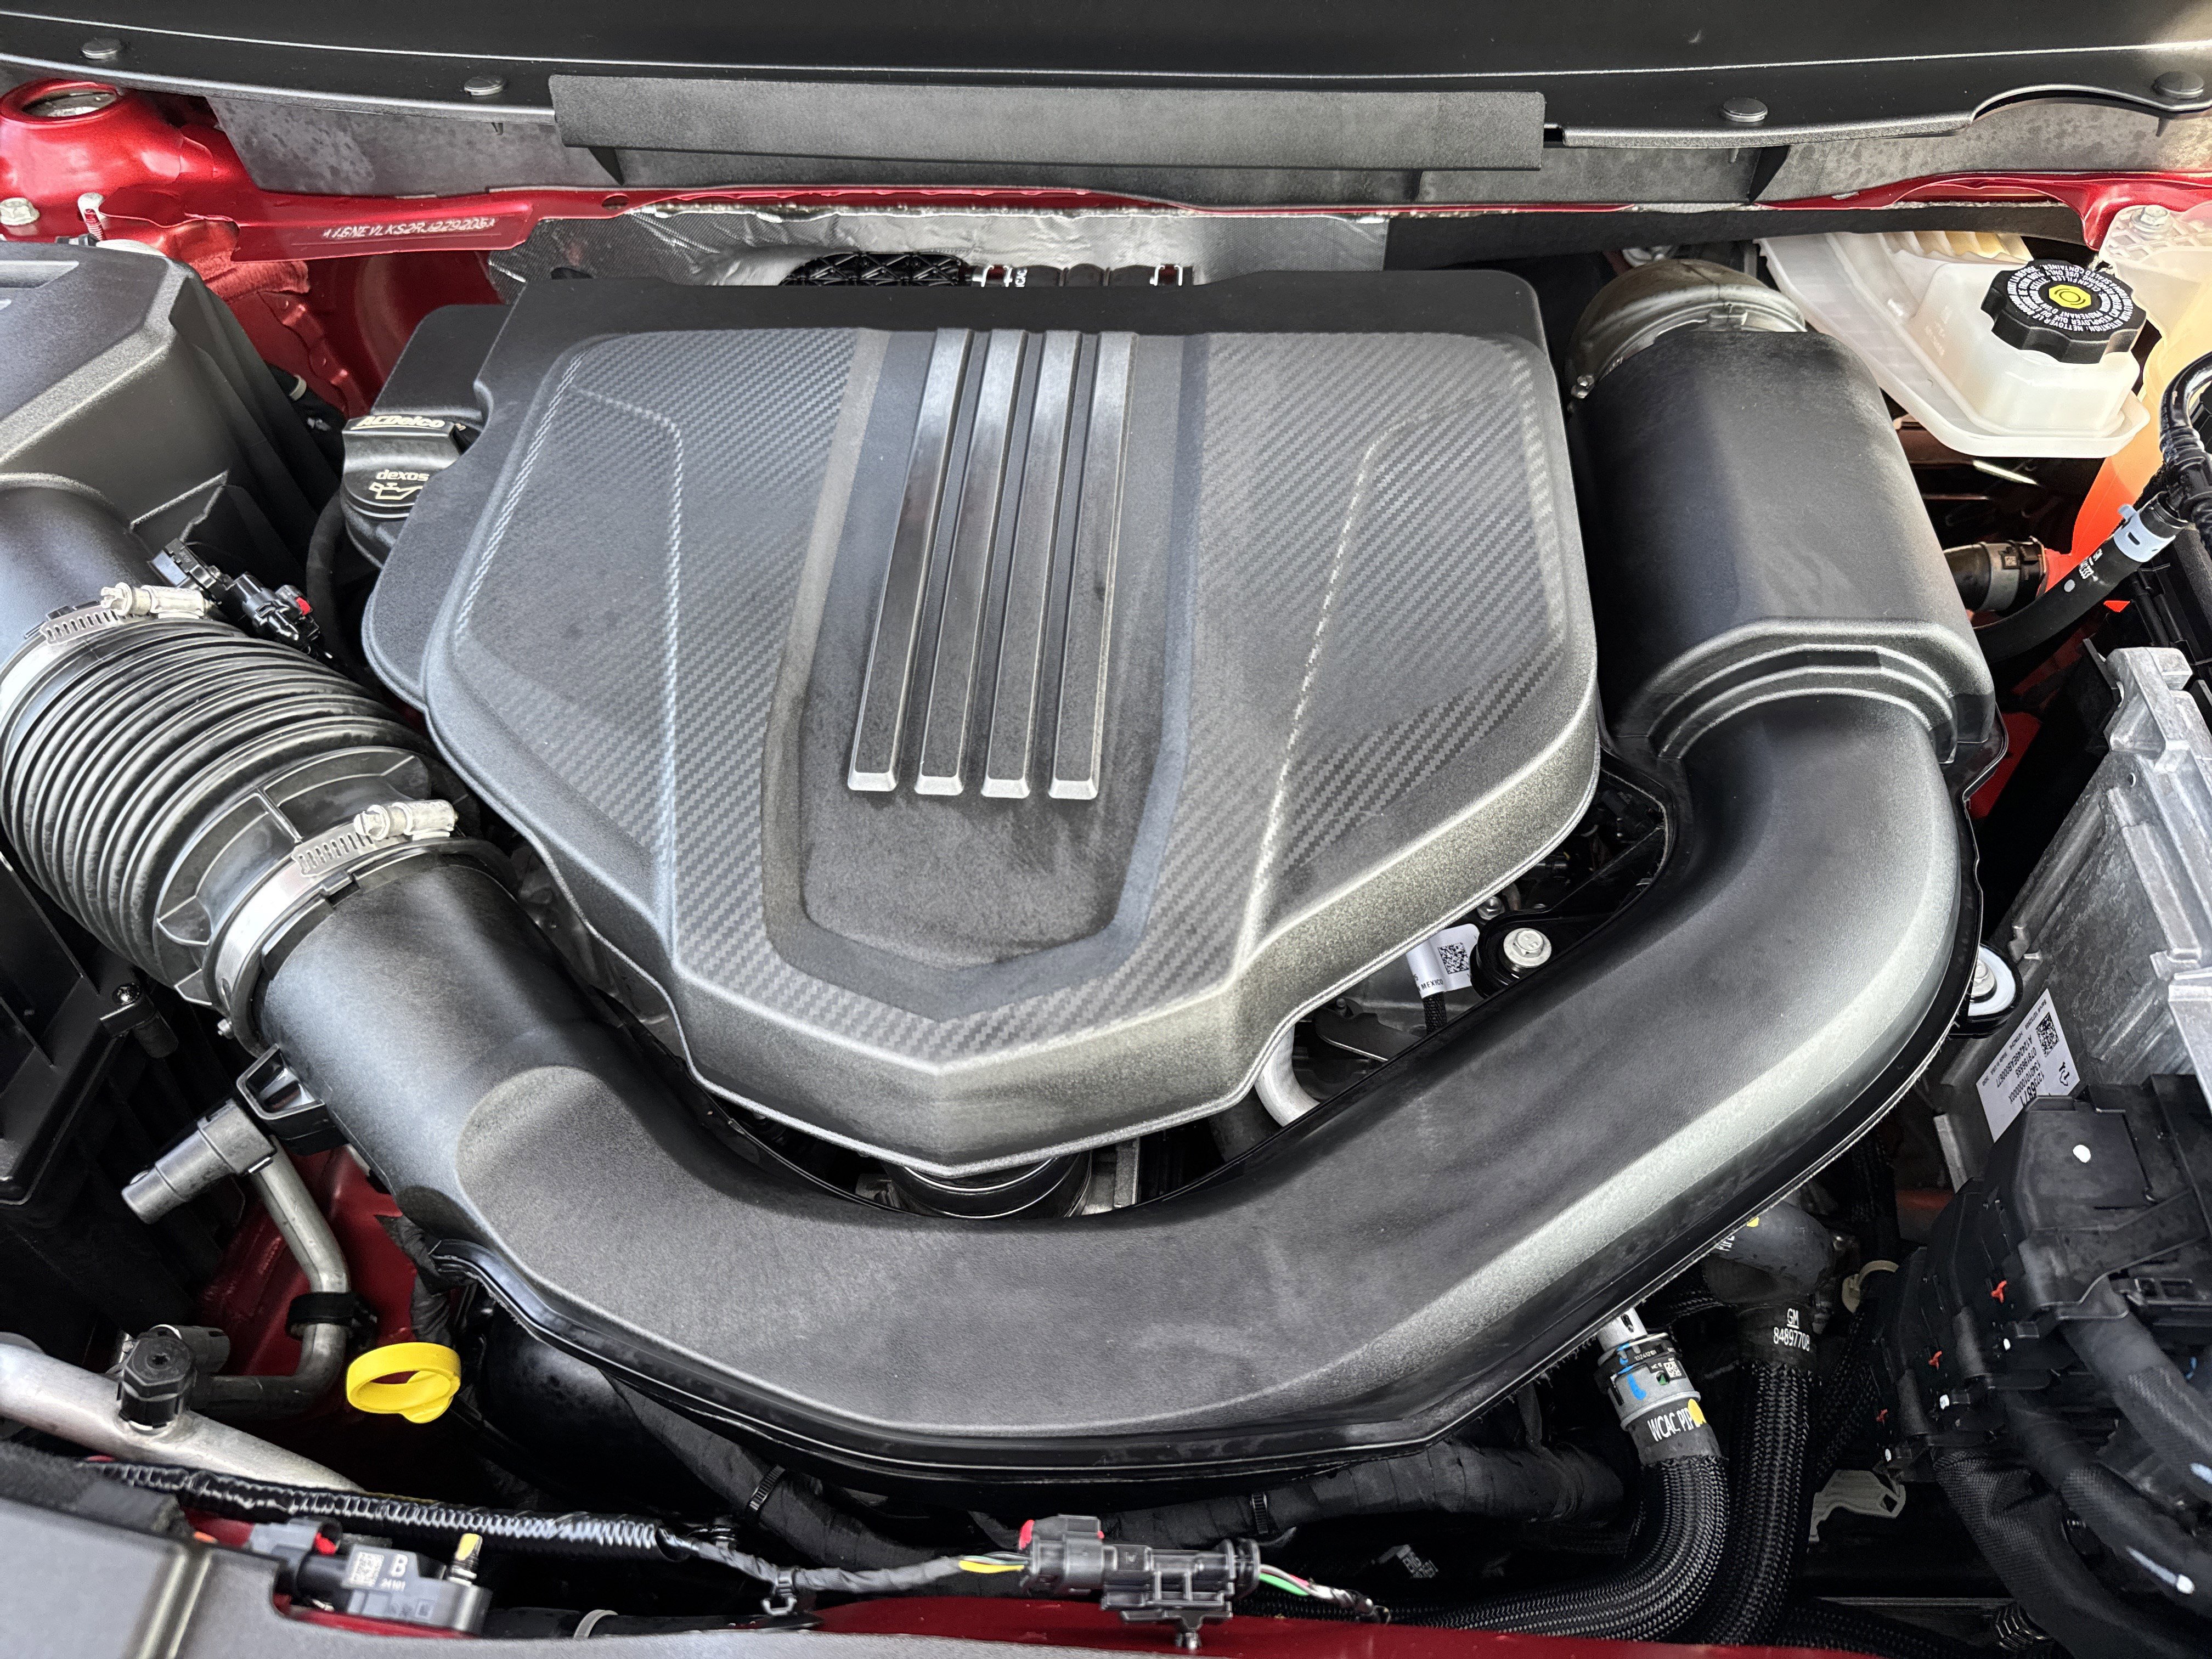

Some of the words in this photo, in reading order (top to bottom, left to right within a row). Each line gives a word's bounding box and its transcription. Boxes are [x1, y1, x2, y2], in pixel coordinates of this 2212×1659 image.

[2051, 275, 2078, 283] FILLER
[2085, 270, 2113, 284] SEALED
[2078, 279, 2101, 292] CLEAN
[2053, 315, 2068, 324] QUE
[2060, 311, 2102, 320] PROVENANT
[2044, 318, 2084, 331] NETTOYER
[357, 415, 445, 428] ACDelco
[376, 470, 430, 481] dexos
[1420, 979, 1443, 990] MEXICO
[1787, 1308, 1799, 1326] GM
[1773, 1327, 1810, 1352] 84897708
[1647, 1412, 1681, 1441] WCAC
[1677, 1408, 1701, 1432] PIP
[390, 1553, 408, 1577] B
